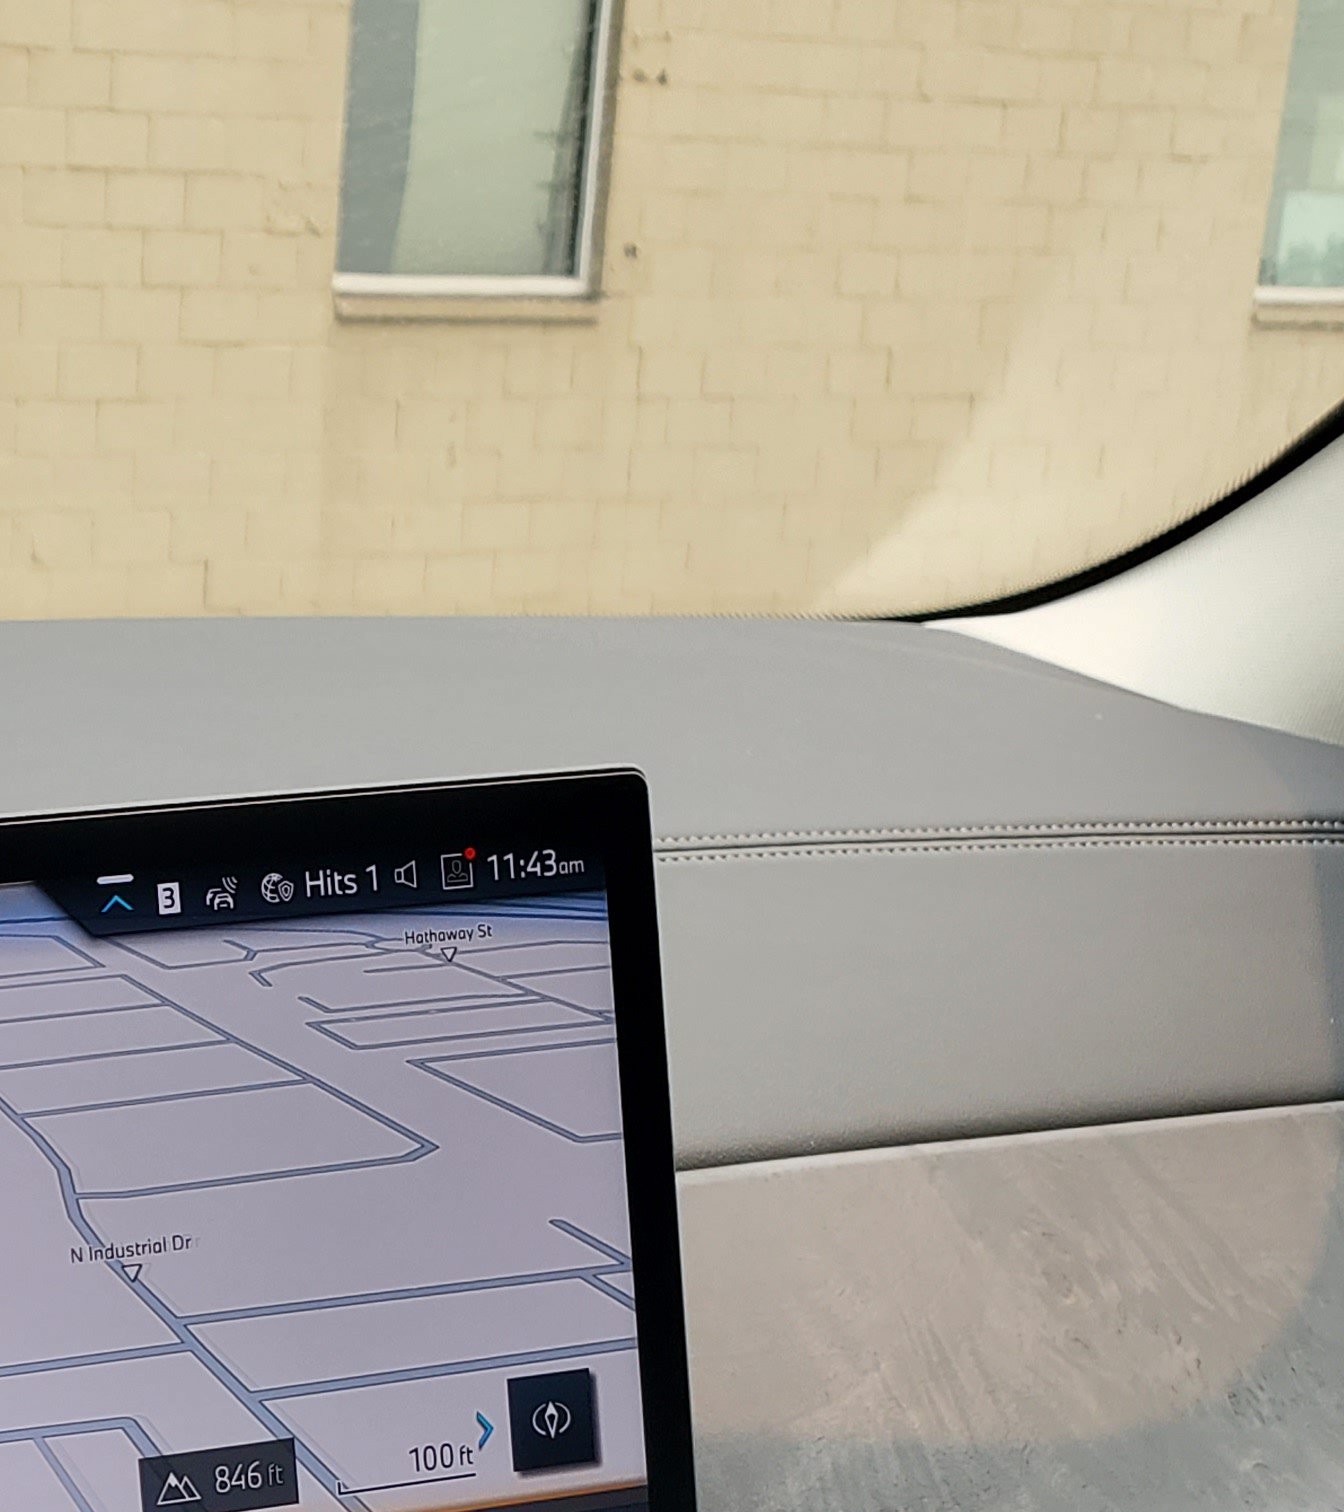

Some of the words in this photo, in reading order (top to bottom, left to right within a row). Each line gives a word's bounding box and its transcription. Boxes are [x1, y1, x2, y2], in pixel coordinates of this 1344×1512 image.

[487, 849, 585, 880] 11:43am
[305, 869, 358, 898] Hits
[365, 864, 378, 891] 1
[405, 928, 475, 945] Hathaway
[477, 924, 493, 938] St
[70, 1248, 83, 1263] N
[89, 1237, 167, 1262] Industrial
[172, 1235, 192, 1251] Dr
[408, 1443, 454, 1472] 100
[459, 1445, 474, 1466] ft
[215, 1461, 262, 1494] 846
[268, 1464, 284, 1486] ft
